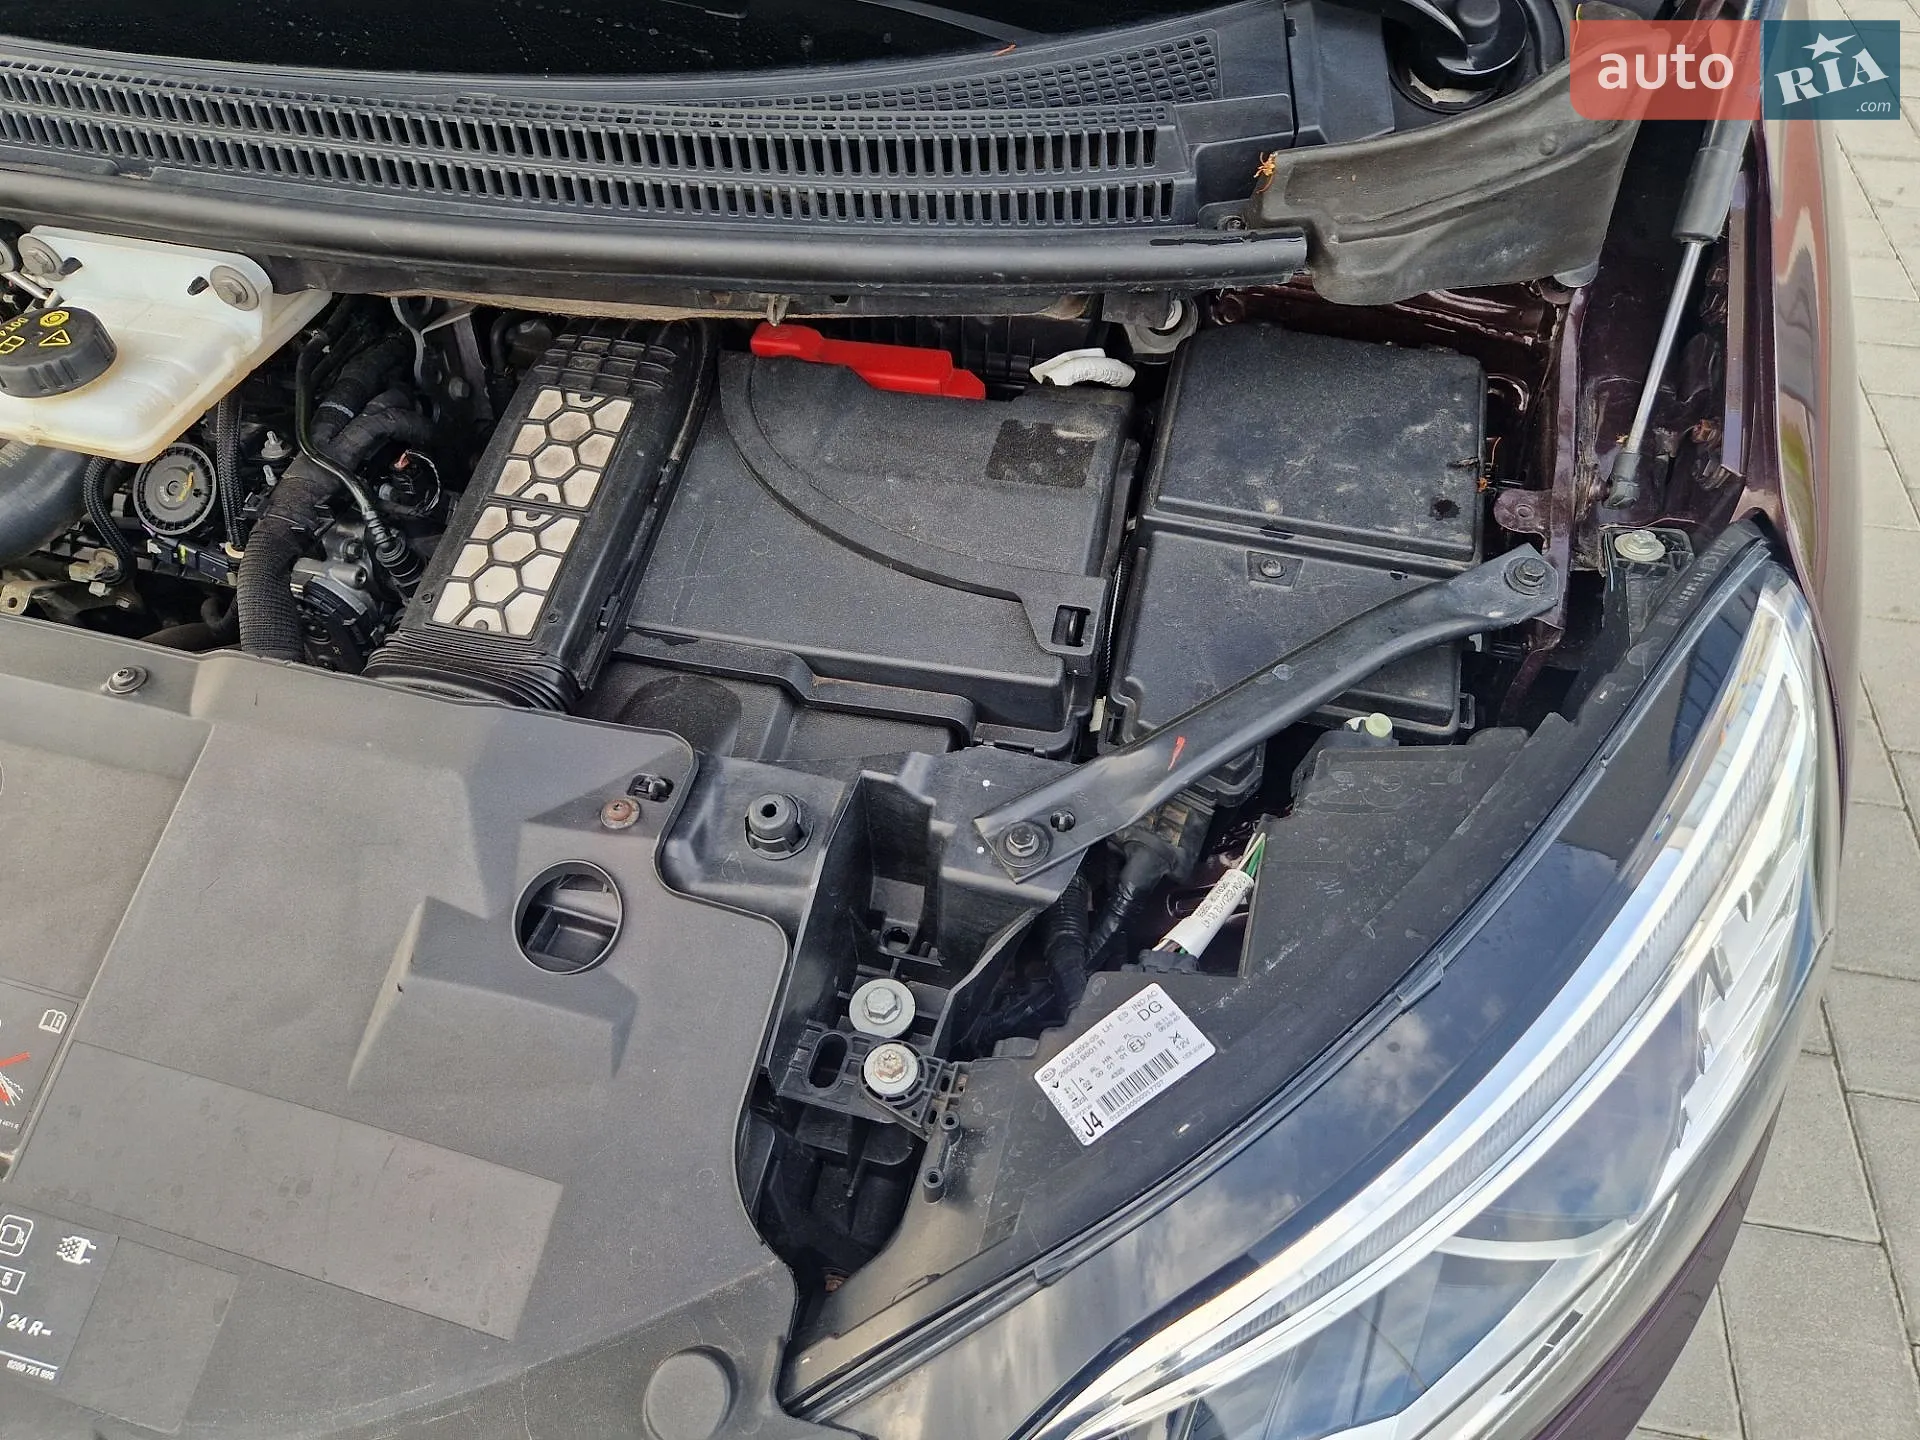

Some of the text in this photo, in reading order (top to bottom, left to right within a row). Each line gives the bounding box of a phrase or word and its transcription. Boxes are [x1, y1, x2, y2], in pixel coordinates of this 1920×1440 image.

[1137, 1000, 1163, 1021] DG
[1129, 1039, 1143, 1052] E1
[1081, 1111, 1104, 1138] J4
[6, 1314, 28, 1332] 24
[26, 1365, 41, 1376] 721
